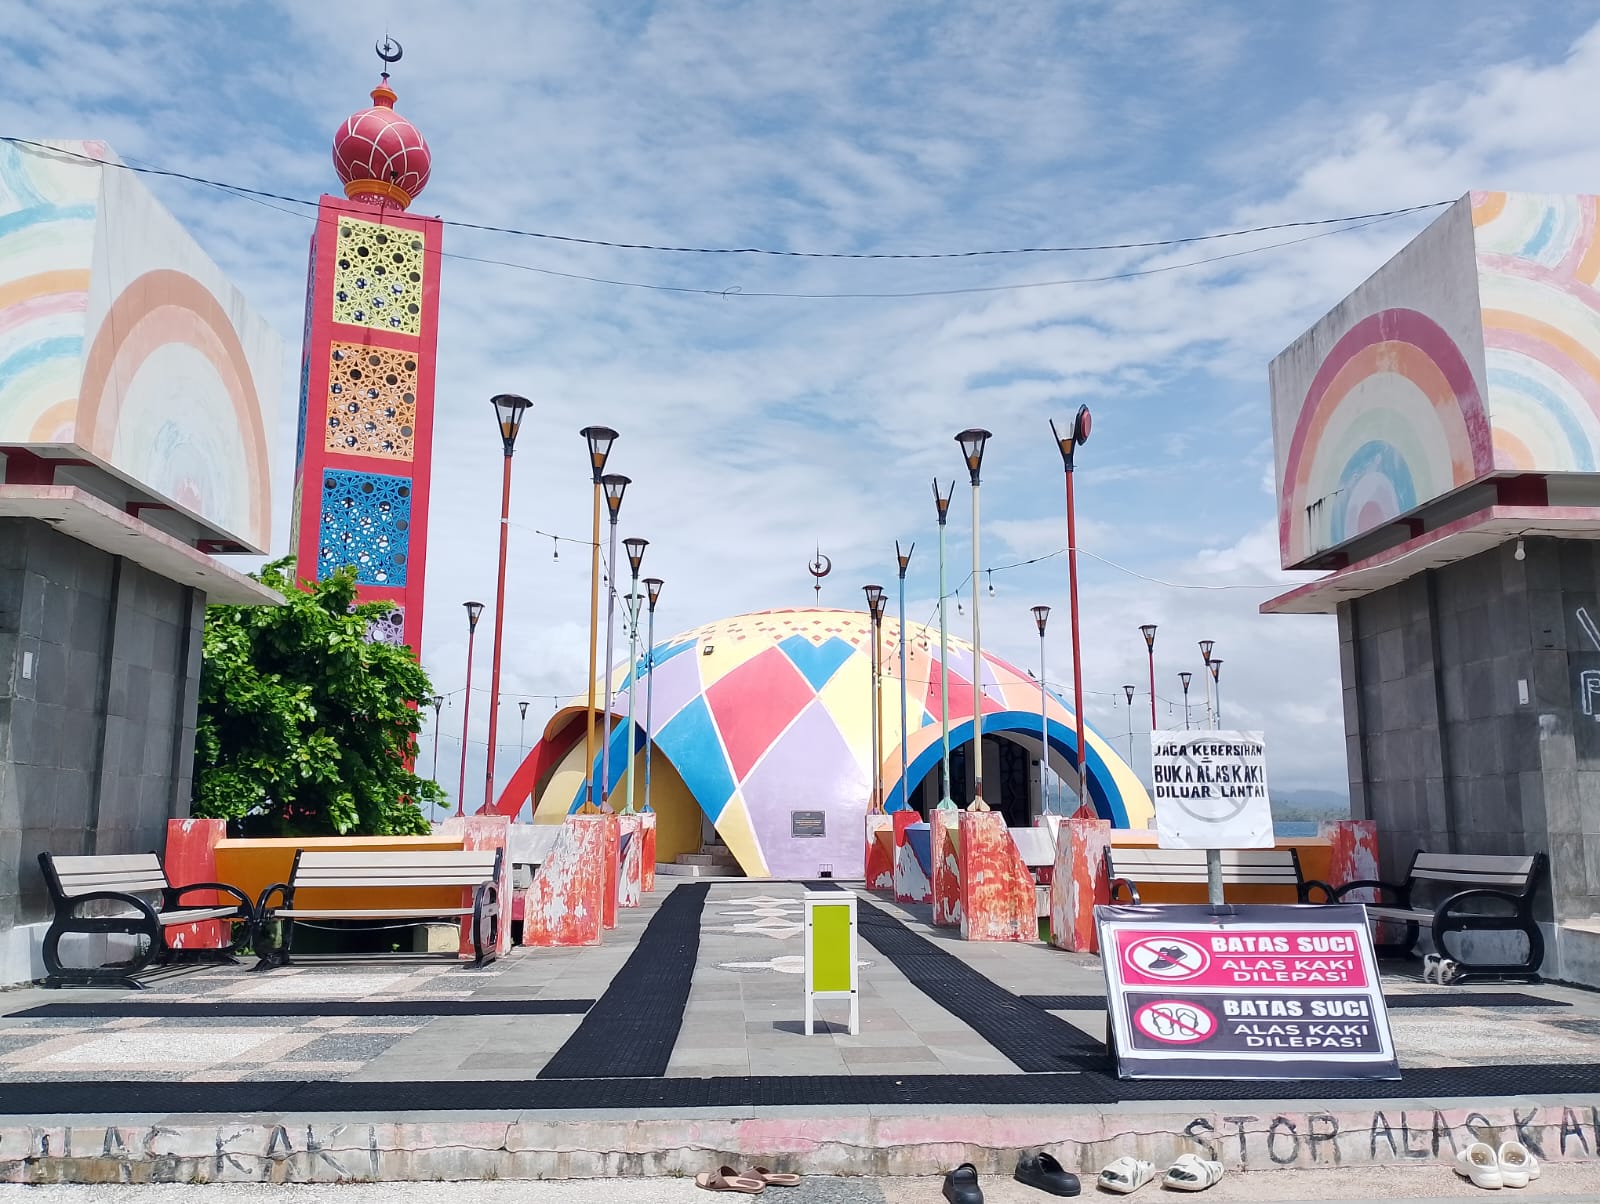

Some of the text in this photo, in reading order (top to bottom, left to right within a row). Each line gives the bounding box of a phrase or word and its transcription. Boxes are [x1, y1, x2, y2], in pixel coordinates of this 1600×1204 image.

[1192, 744, 1263, 757] KEBERSIHAN
[1154, 764, 1264, 783] BUKA ALAS KAKI
[1156, 785, 1265, 798] DILUAR LANTAI
[1210, 935, 1355, 953] BATAS SUCI
[1221, 959, 1354, 971] ALAS KAKI
[1233, 971, 1348, 982] DILEPAS!
[1223, 999, 1369, 1017] BATAS SUCI
[1234, 1024, 1369, 1036] ALAS KAKI
[1246, 1036, 1363, 1048] DILEPAS!
[1513, 1105, 1600, 1161] KA
